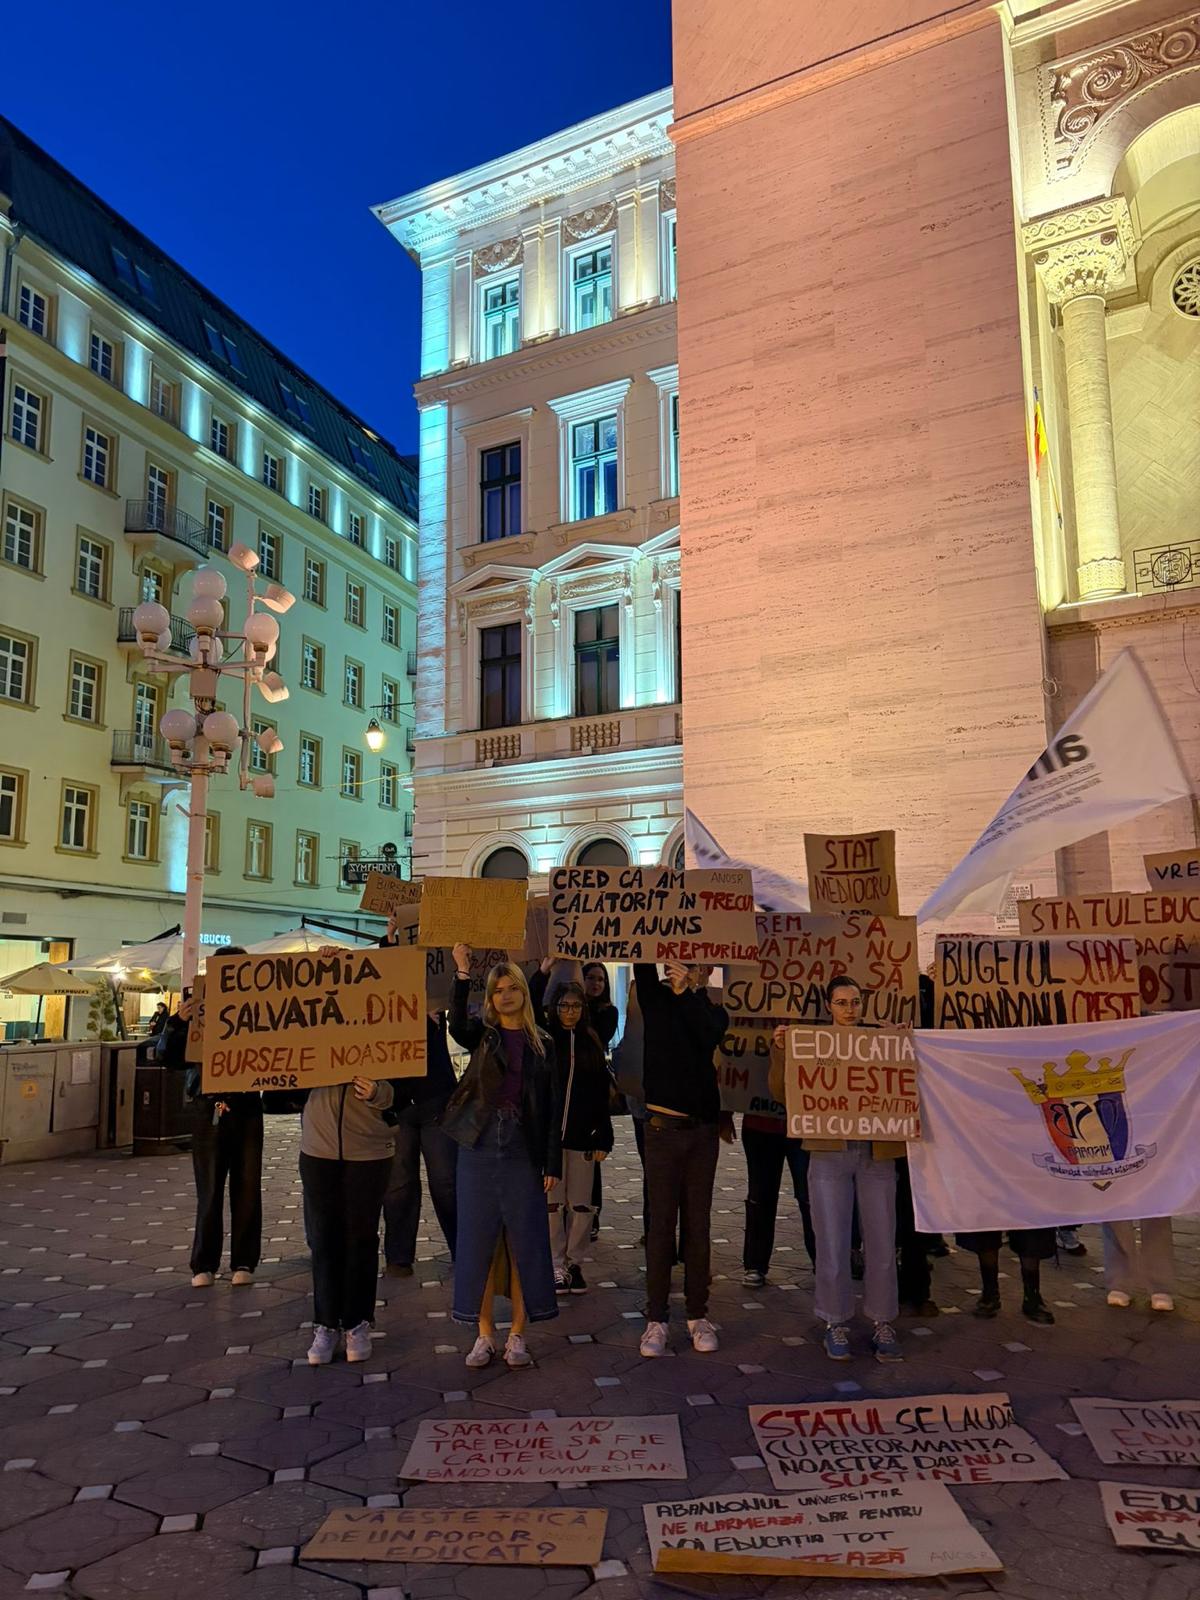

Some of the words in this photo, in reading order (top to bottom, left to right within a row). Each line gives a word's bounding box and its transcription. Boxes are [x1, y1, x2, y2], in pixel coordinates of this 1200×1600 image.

[825, 837, 881, 869] STAT
[348, 863, 397, 873] SYMPHONY
[553, 869, 610, 889] CRED
[656, 871, 685, 889] AM
[813, 874, 892, 905] MEDIOCRU
[1031, 898, 1141, 933] STATUL
[592, 916, 621, 937] AM
[632, 915, 702, 936] AJUNS
[866, 939, 913, 963] NU
[938, 938, 1066, 989] BUGETUL
[1066, 937, 1137, 986] SCADE
[865, 961, 905, 991] SĂ
[210, 1047, 315, 1077] BURSELE
[330, 1040, 426, 1069] NOASTRE
[251, 1074, 298, 1088] ANOSR
[798, 1065, 838, 1092] NU
[847, 1065, 917, 1097] ESTE
[802, 1094, 849, 1112] DOAR
[790, 1113, 822, 1136] CEI
[826, 1115, 854, 1136] CU
[568, 1419, 615, 1433] NU
[757, 1407, 894, 1438] STATUL
[896, 1406, 933, 1435] SE
[426, 1436, 555, 1453] TREBUIE
[615, 1433, 667, 1446] FIE
[1111, 1428, 1200, 1448] EDU
[442, 1449, 590, 1467] CRITERIU
[608, 1448, 648, 1461] DE
[766, 1438, 808, 1459] CU
[915, 1454, 965, 1470] DAR
[964, 1453, 1006, 1467] NU
[1012, 1452, 1036, 1464] O
[409, 1467, 527, 1479] ABANDON
[396, 1510, 481, 1524] ESTE
[656, 1498, 789, 1518] ABANDONUL
[661, 1520, 689, 1536] NE
[817, 1508, 850, 1524] DAR
[859, 1504, 924, 1521] PENTRU
[319, 1530, 362, 1545] DE
[367, 1529, 416, 1544] UN
[423, 1529, 534, 1543] POPOR
[832, 1530, 896, 1544] TOT
[384, 1543, 530, 1561] EDUCAT
